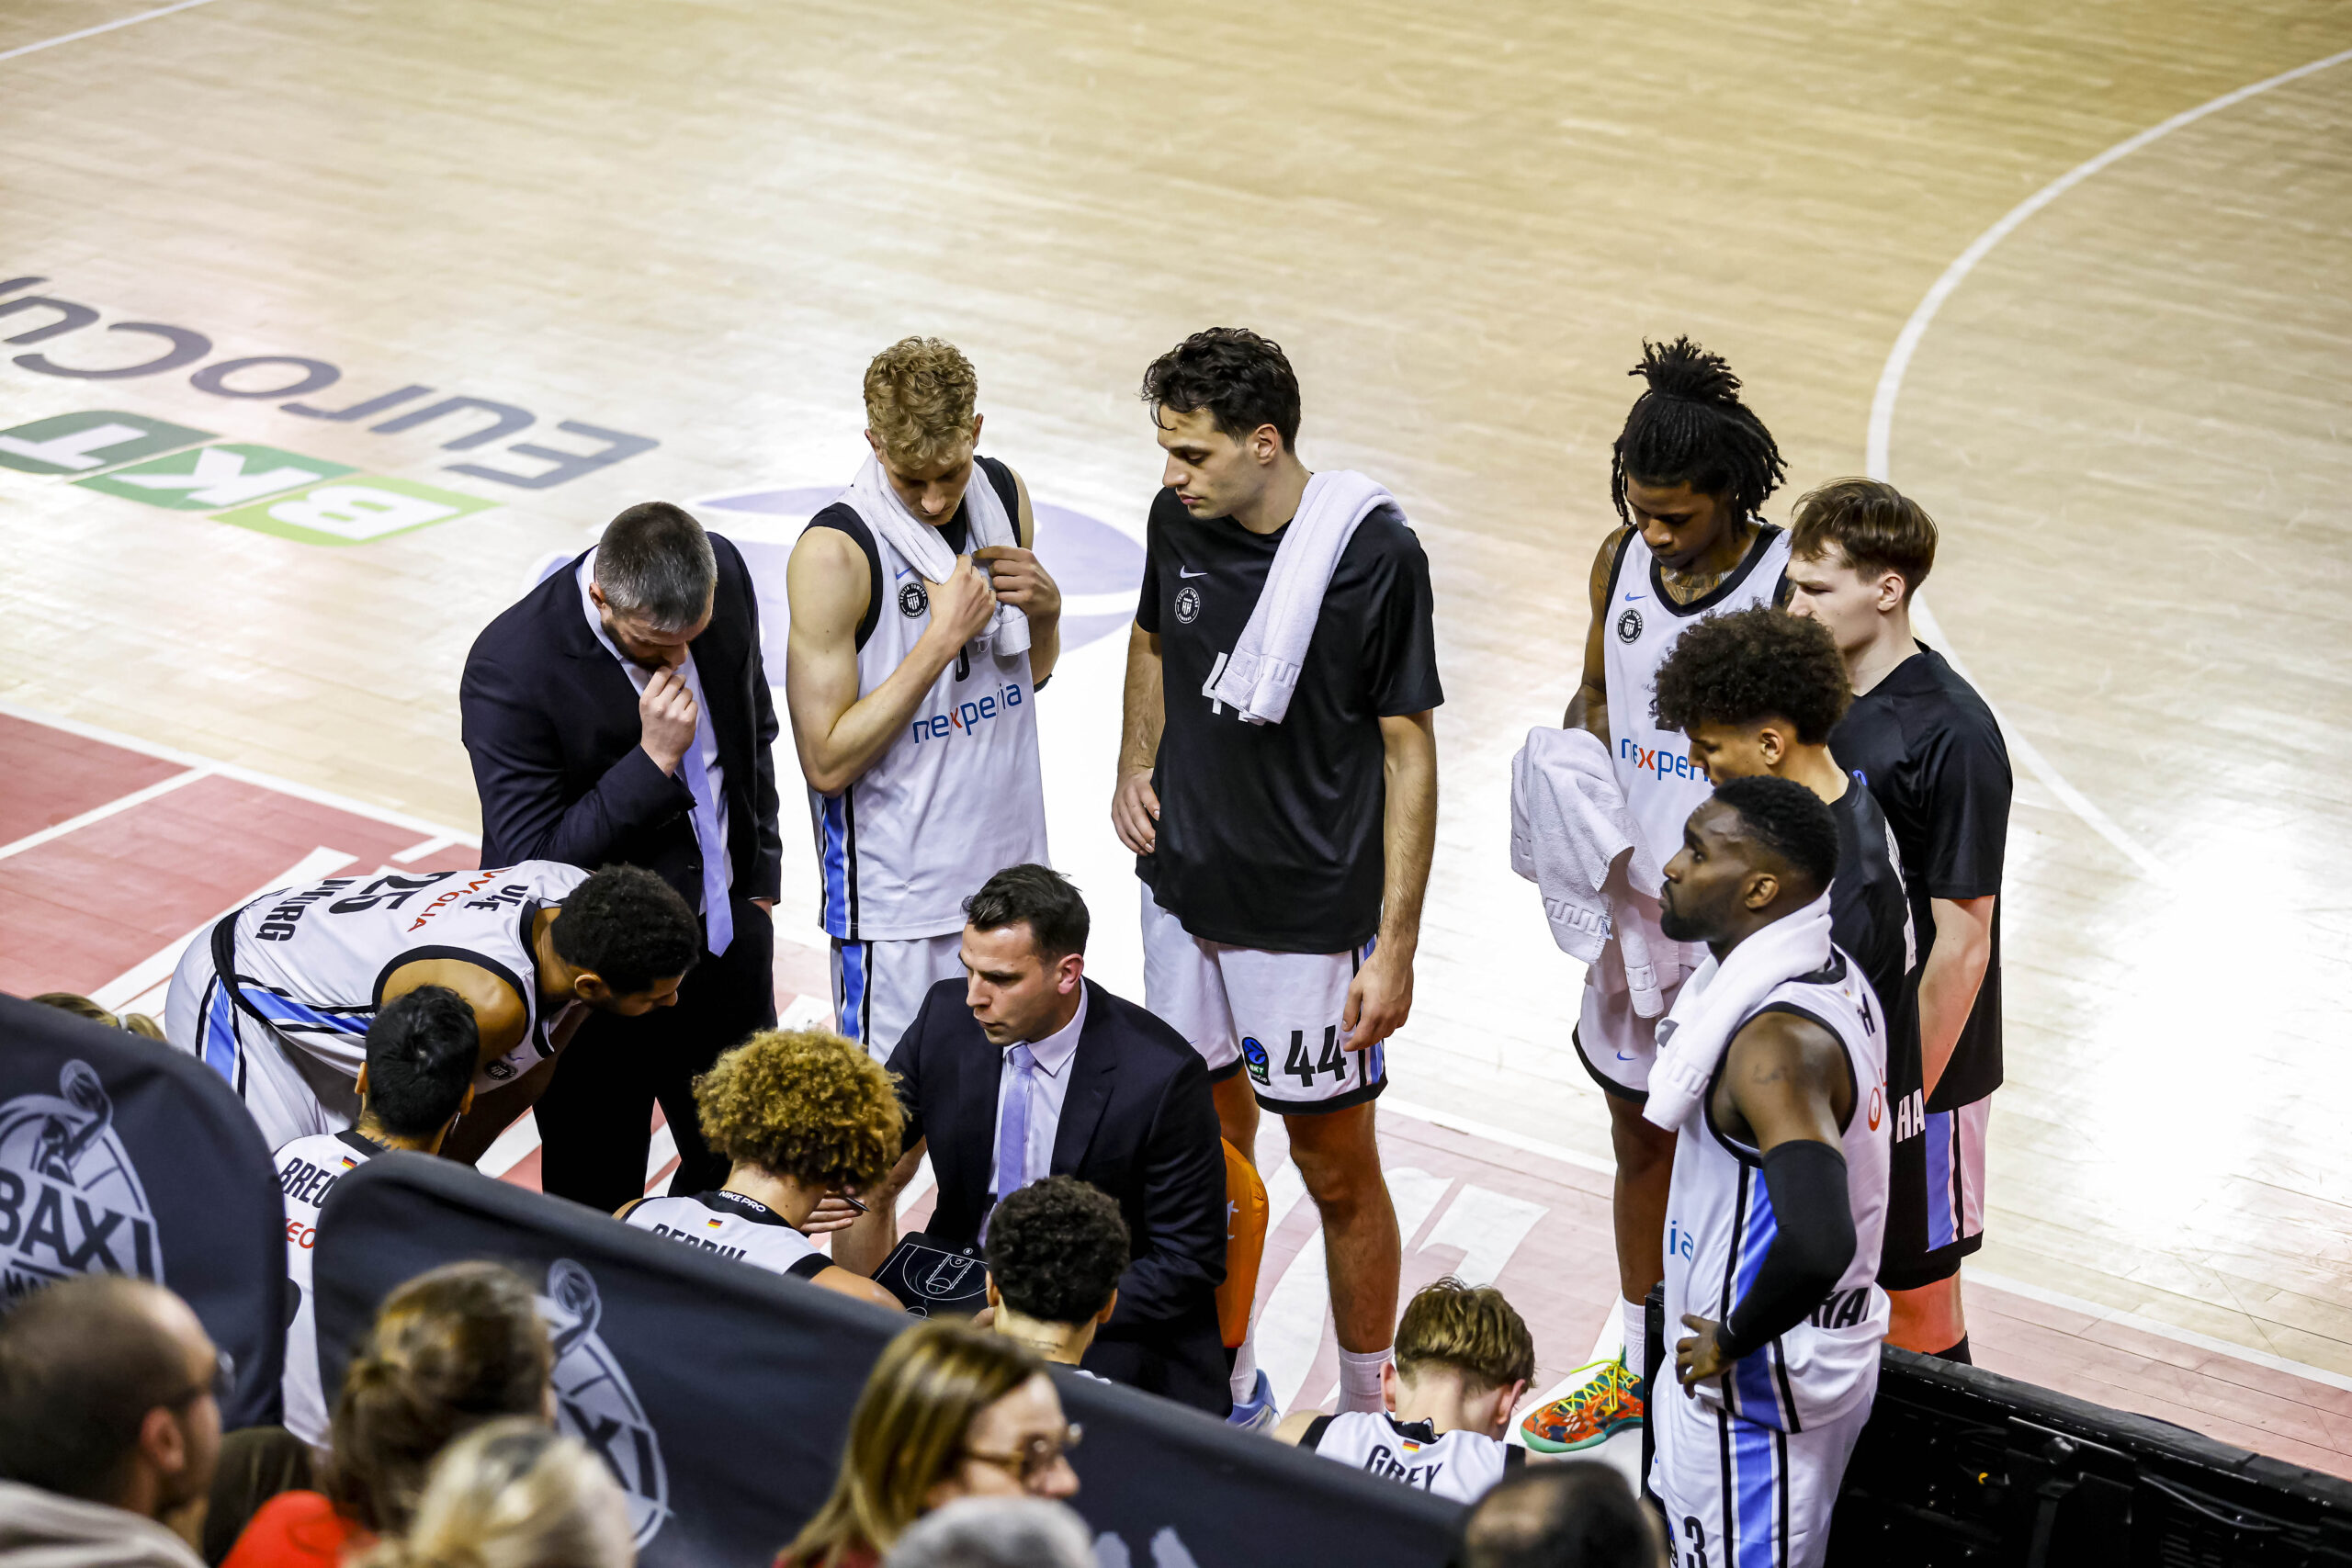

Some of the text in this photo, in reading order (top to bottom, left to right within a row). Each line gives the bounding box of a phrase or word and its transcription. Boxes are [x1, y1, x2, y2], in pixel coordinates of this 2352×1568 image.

[0, 276, 661, 489] EuroCu
[0, 423, 461, 541] BKT
[1283, 1024, 1348, 1088] 44
[718, 1190, 766, 1213] NIKE PRO
[1810, 1287, 1871, 1329] HA
[1363, 1444, 1444, 1491] GREY
